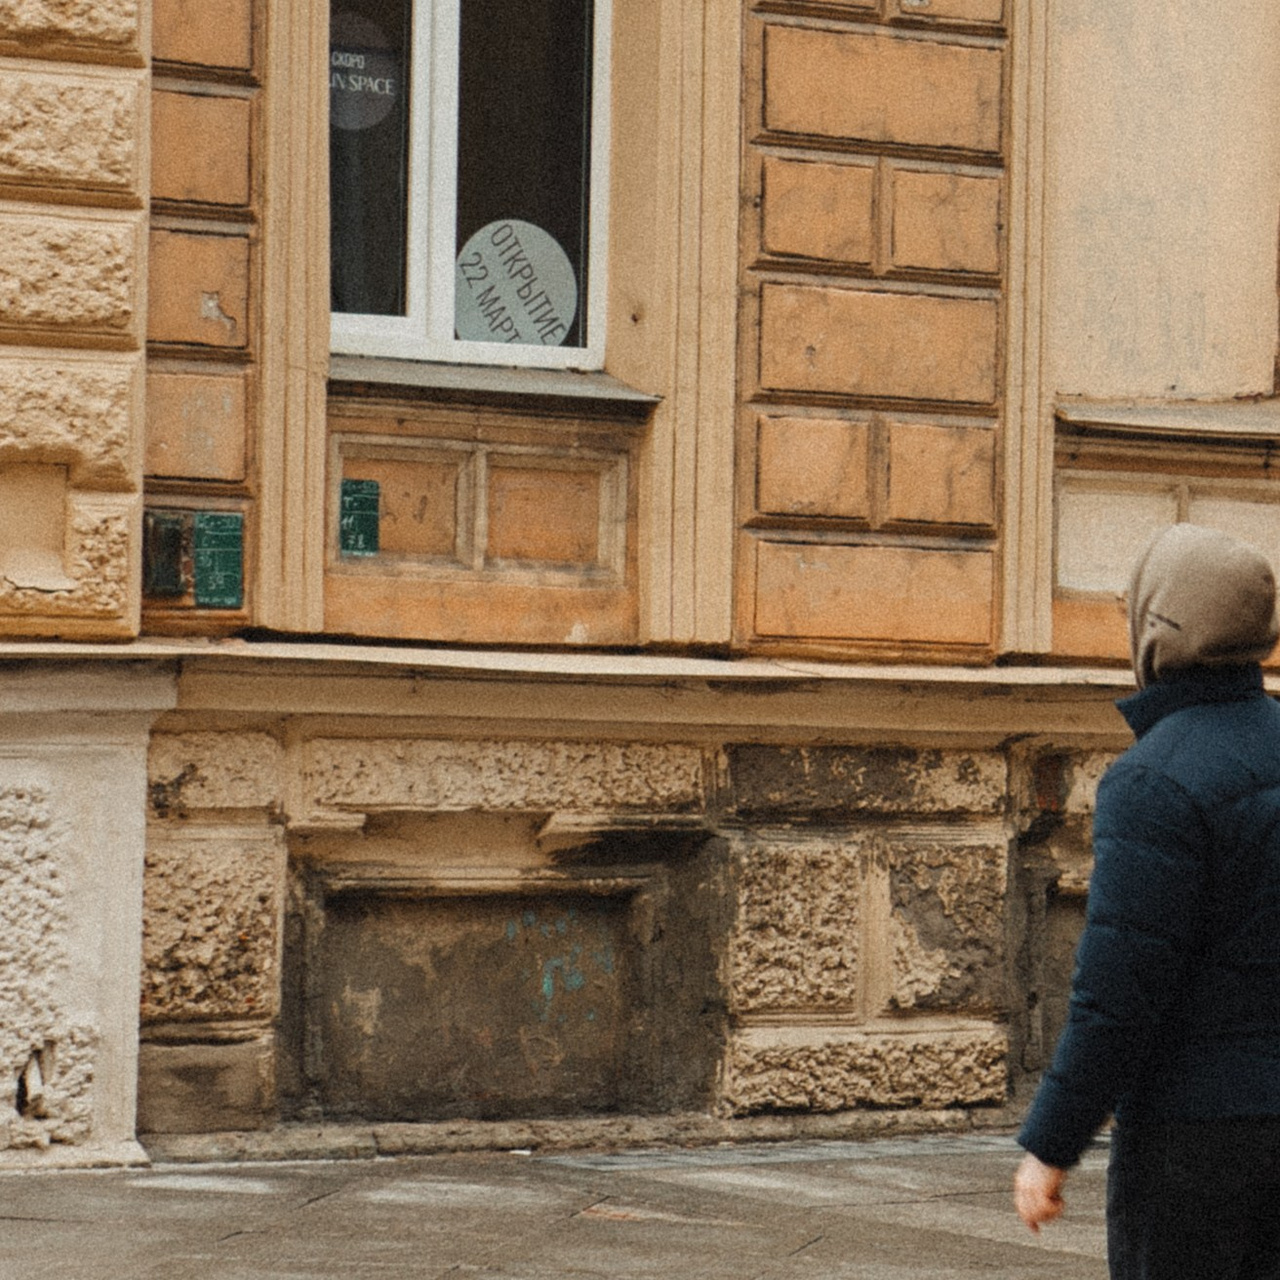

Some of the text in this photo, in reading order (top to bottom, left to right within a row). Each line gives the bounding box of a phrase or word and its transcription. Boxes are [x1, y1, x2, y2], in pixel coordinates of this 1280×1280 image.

[349, 74, 395, 96] SPACE
[459, 252, 488, 289] 22
[491, 223, 566, 345] ОТКРЫТИЕ
